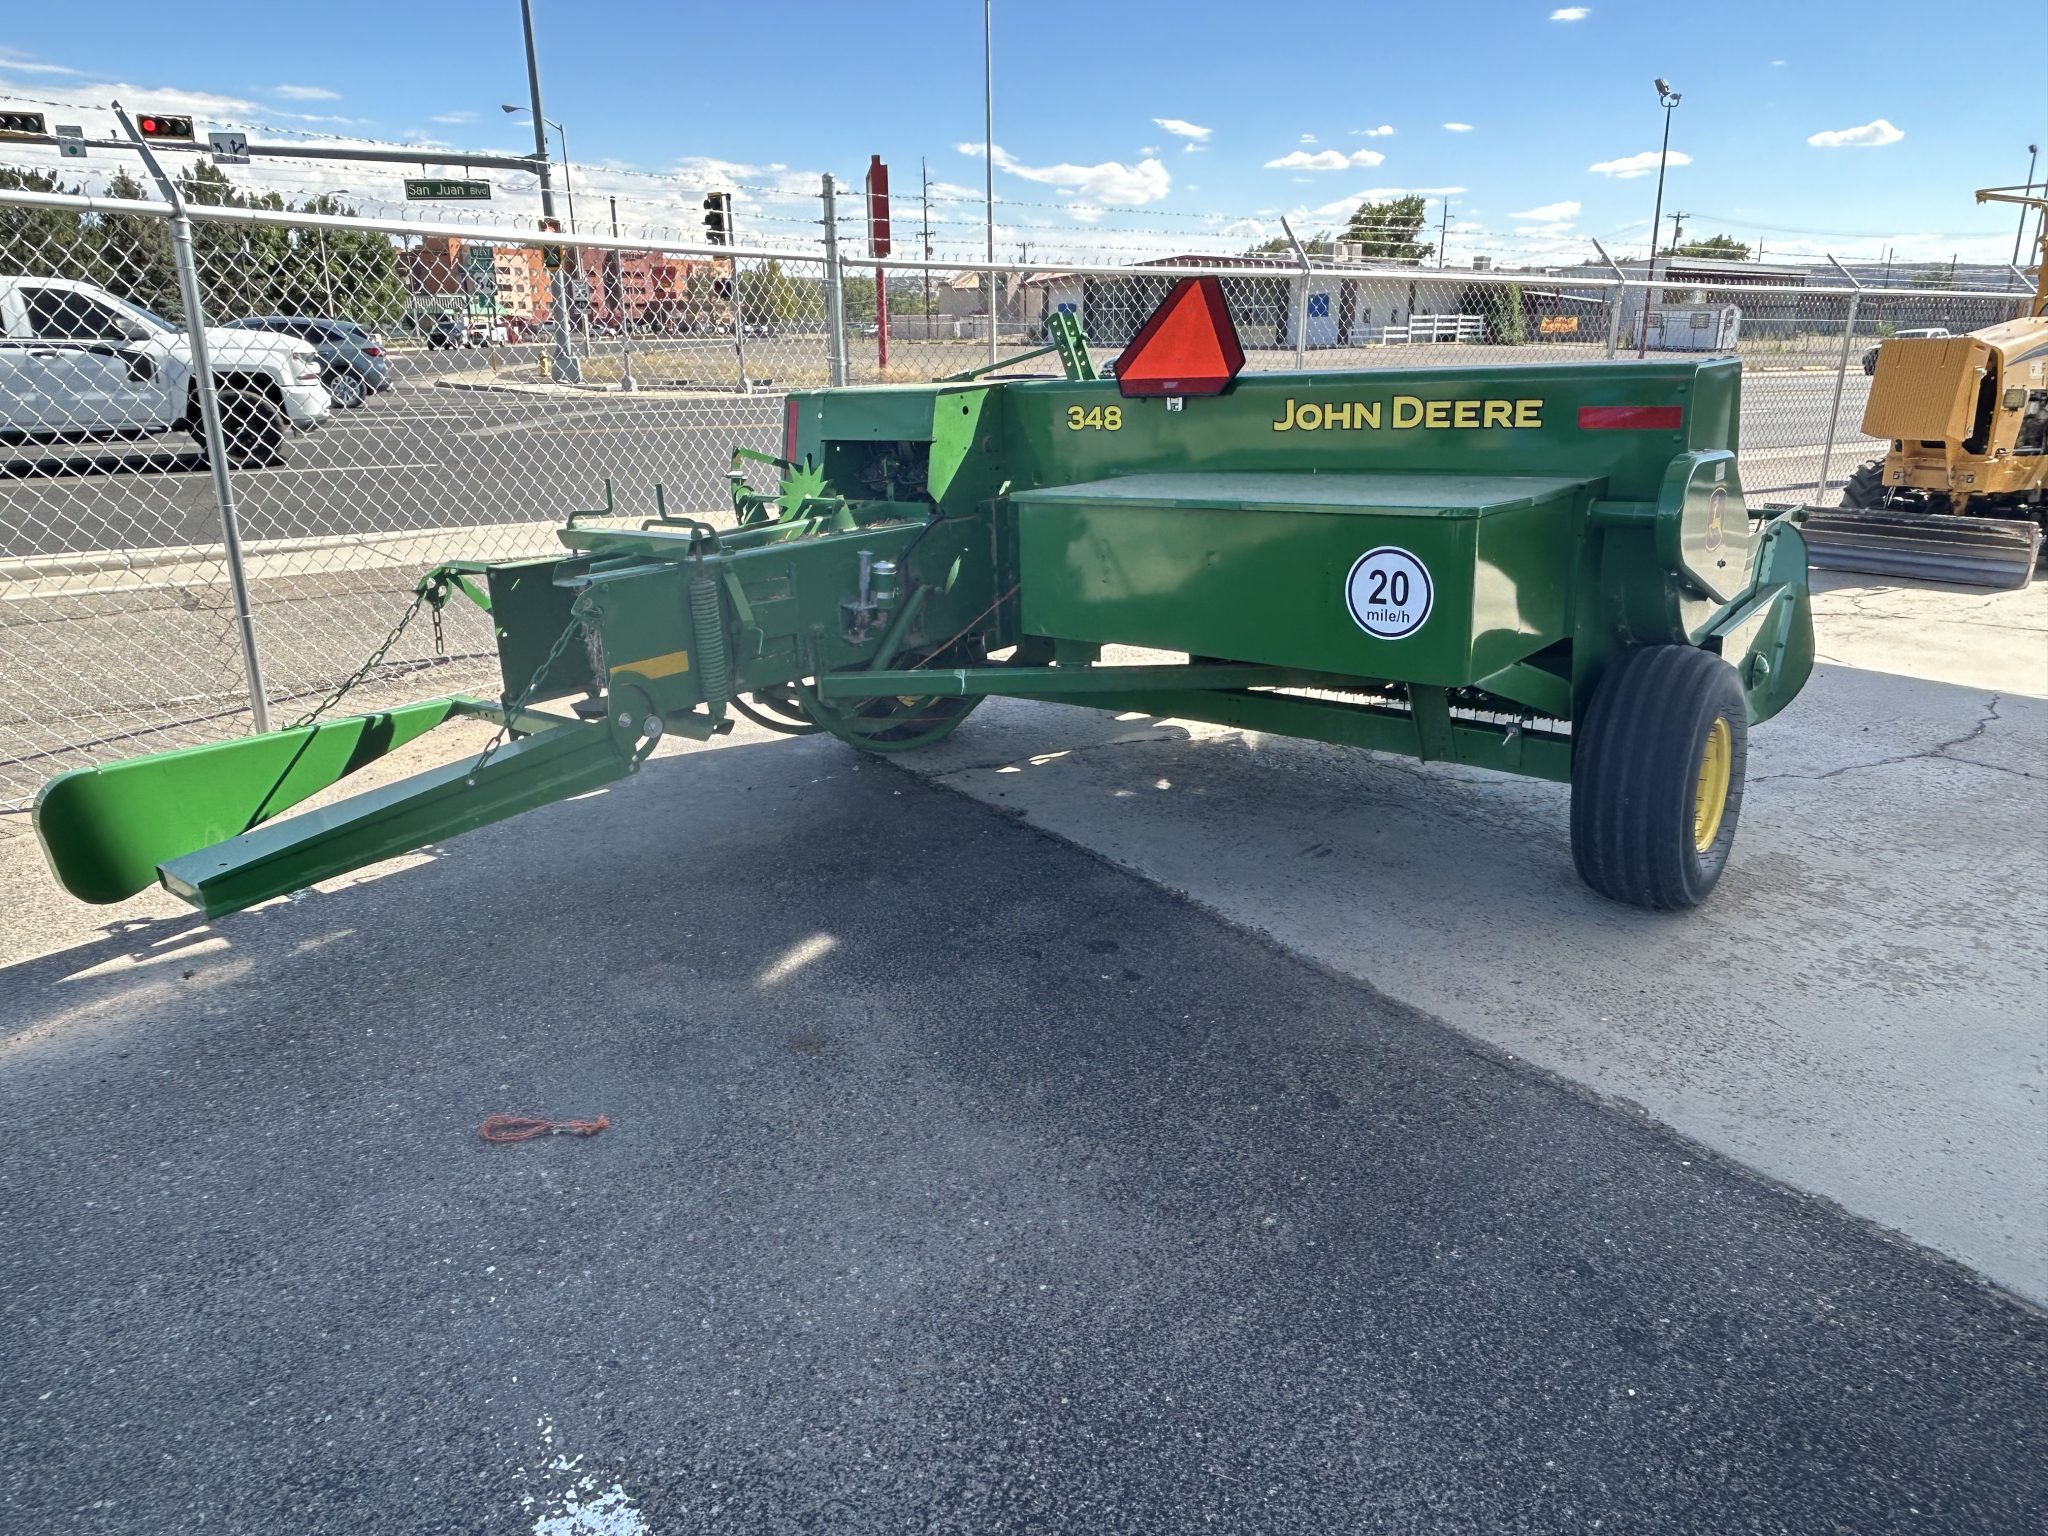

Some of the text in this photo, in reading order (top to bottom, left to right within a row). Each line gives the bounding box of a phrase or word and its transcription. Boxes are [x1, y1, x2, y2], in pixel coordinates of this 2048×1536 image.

[408, 184, 487, 196] San Juan Blvd
[1066, 404, 1123, 431] 348
[1273, 395, 1544, 431] JOHN DEERE
[1368, 569, 1409, 607] 20
[1366, 608, 1410, 624] mile/h
